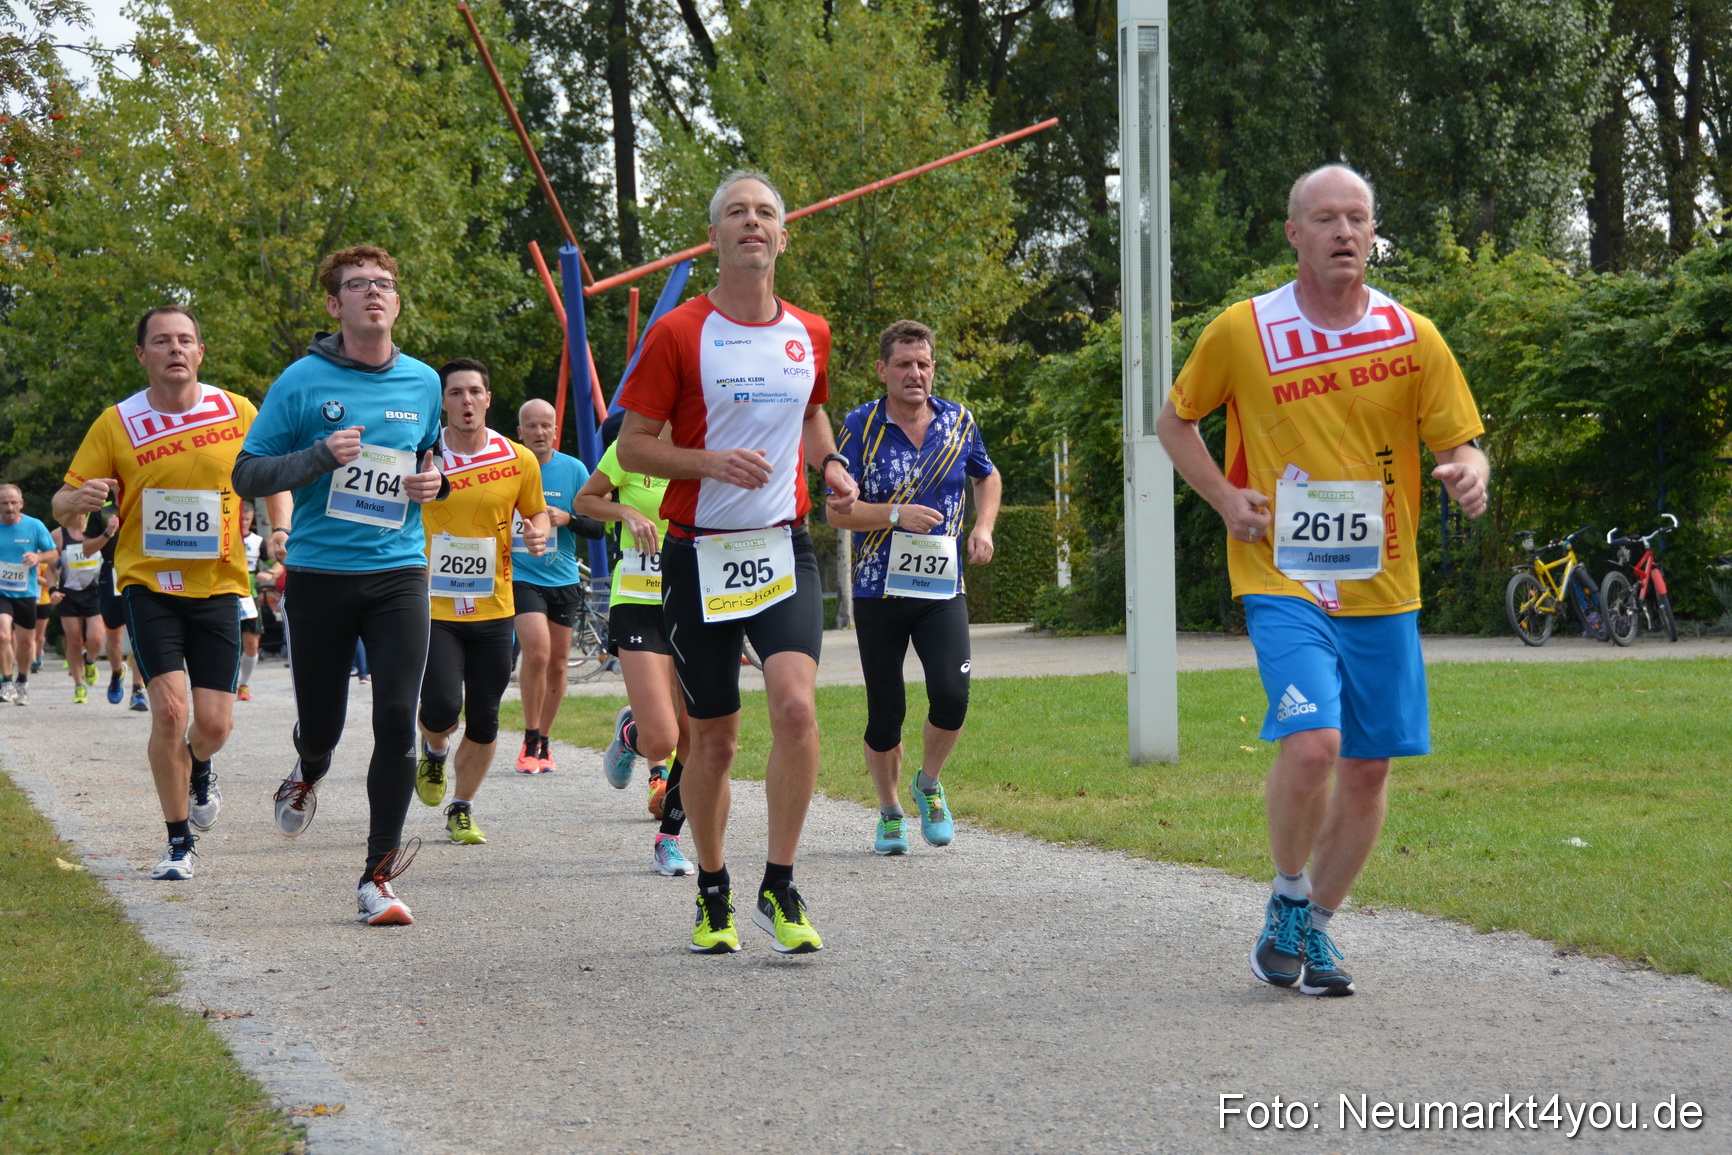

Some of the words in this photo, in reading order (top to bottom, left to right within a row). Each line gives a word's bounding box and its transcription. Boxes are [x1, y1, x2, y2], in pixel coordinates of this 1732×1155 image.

[783, 367, 811, 378] KOPPE
[1272, 372, 1342, 405] MAX
[1349, 354, 1421, 387] BÖGL
[384, 410, 420, 422] BOCK
[136, 440, 187, 467] MAX
[192, 426, 244, 448] BÖGL
[344, 466, 401, 498] 2164
[450, 476, 474, 492] AX
[477, 465, 522, 484] BÖGL
[1318, 490, 1354, 500] BOCK
[356, 500, 385, 512] Markus
[154, 510, 209, 532] 2618
[1292, 512, 1368, 542] 2615
[166, 538, 198, 547] Andreas
[734, 538, 766, 549] BOCK
[440, 554, 487, 574] 2629
[638, 552, 662, 572] 19
[898, 552, 949, 575] 2137
[1306, 552, 1350, 564] Andreas
[2, 570, 24, 580] 2216
[722, 558, 774, 589] 295
[912, 578, 930, 588] Peter
[646, 579, 662, 588] Petr
[708, 584, 780, 610] Christian
[1276, 703, 1318, 722] adidas
